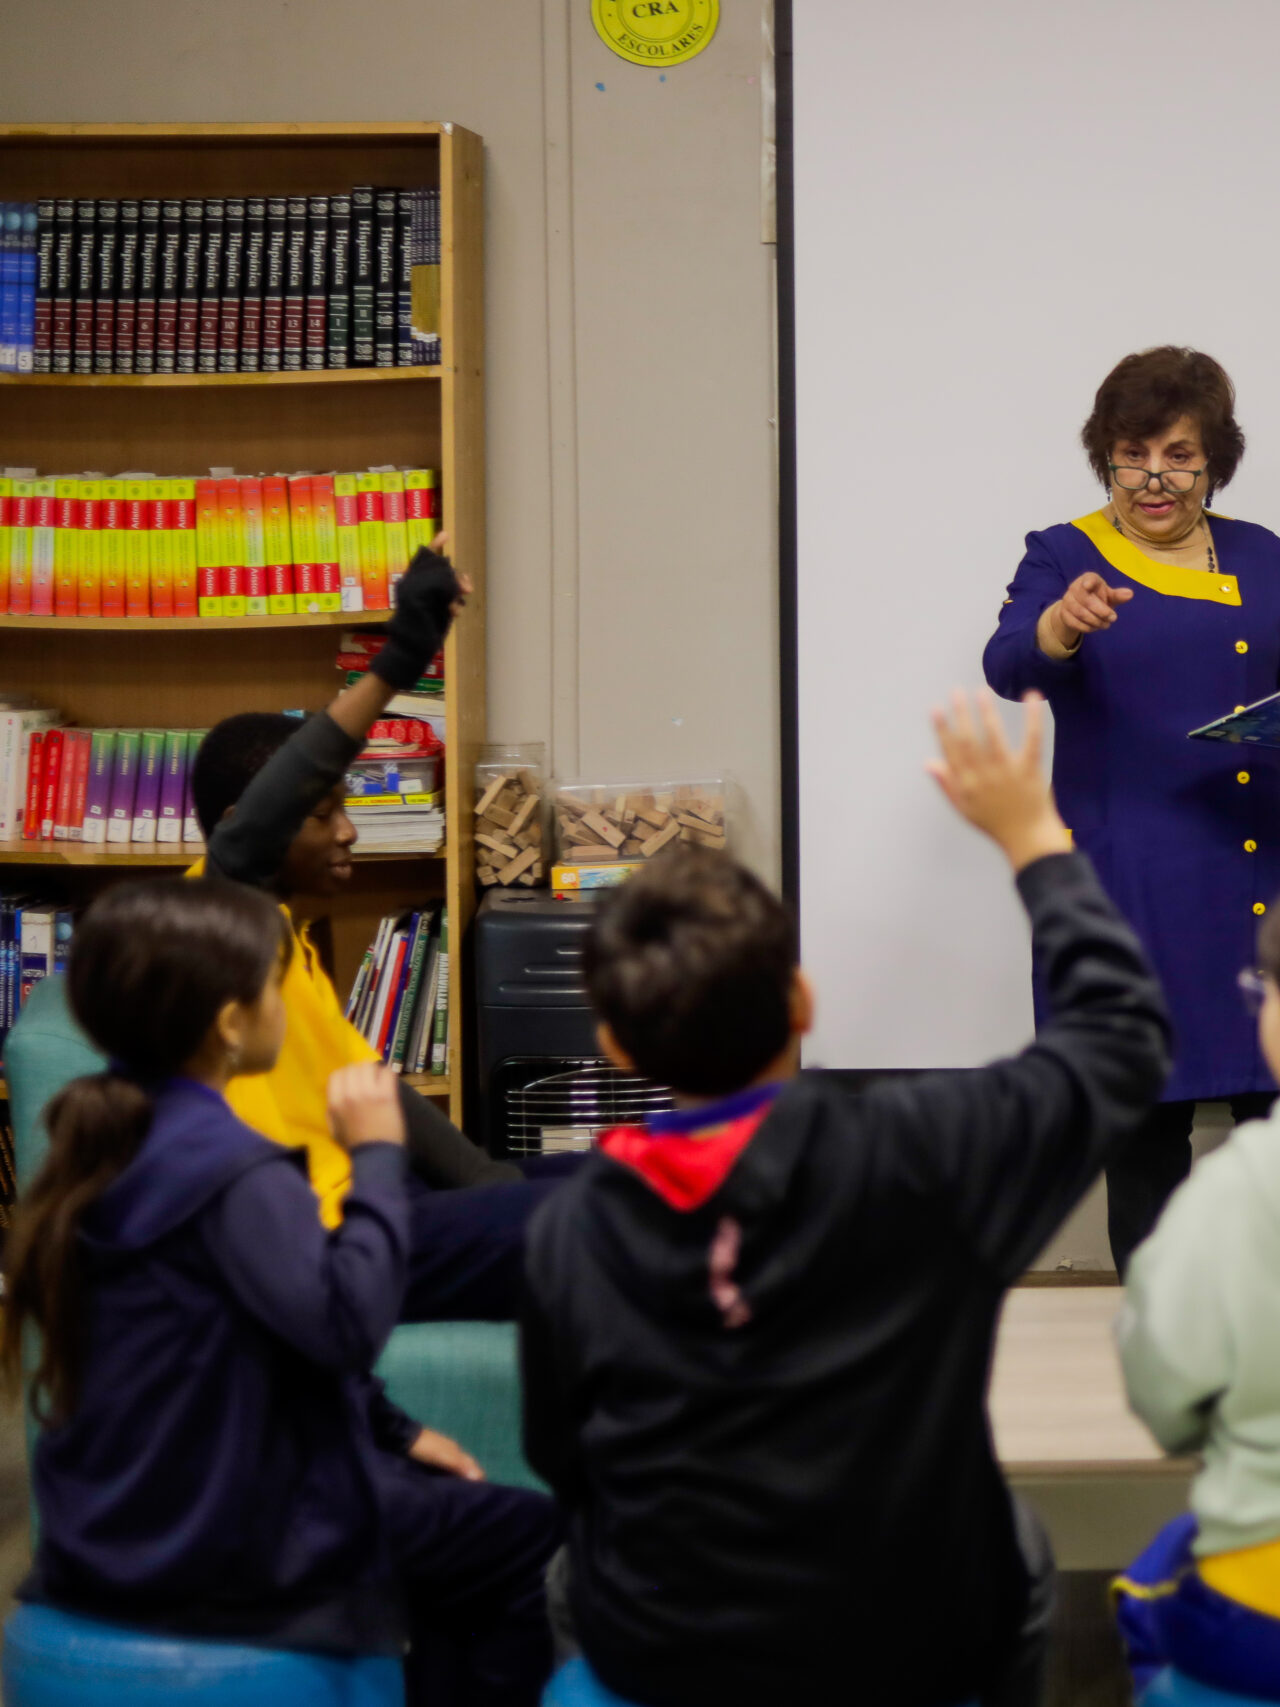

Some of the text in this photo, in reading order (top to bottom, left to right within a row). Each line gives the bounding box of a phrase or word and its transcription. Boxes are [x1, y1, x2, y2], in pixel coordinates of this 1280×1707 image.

[632, 2, 680, 19] CRA
[617, 23, 704, 56] ESCOLARES
[19, 355, 28, 368] 5
[17, 499, 25, 526] Aristos
[39, 499, 48, 526] Aristos
[62, 500, 71, 528] Aristos
[85, 501, 94, 529] Aristos
[108, 501, 116, 529] Aristos
[131, 502, 140, 529] Aristos
[155, 501, 163, 529] Aristos
[178, 501, 186, 529] Aristos
[204, 568, 214, 595] Aristos
[228, 567, 238, 595] Aristos
[250, 568, 259, 595] Aristos
[275, 566, 283, 593] Aristos
[301, 564, 310, 592] Aristos
[323, 564, 331, 592] Aristos
[436, 953, 449, 1011] MARAVILLAS
